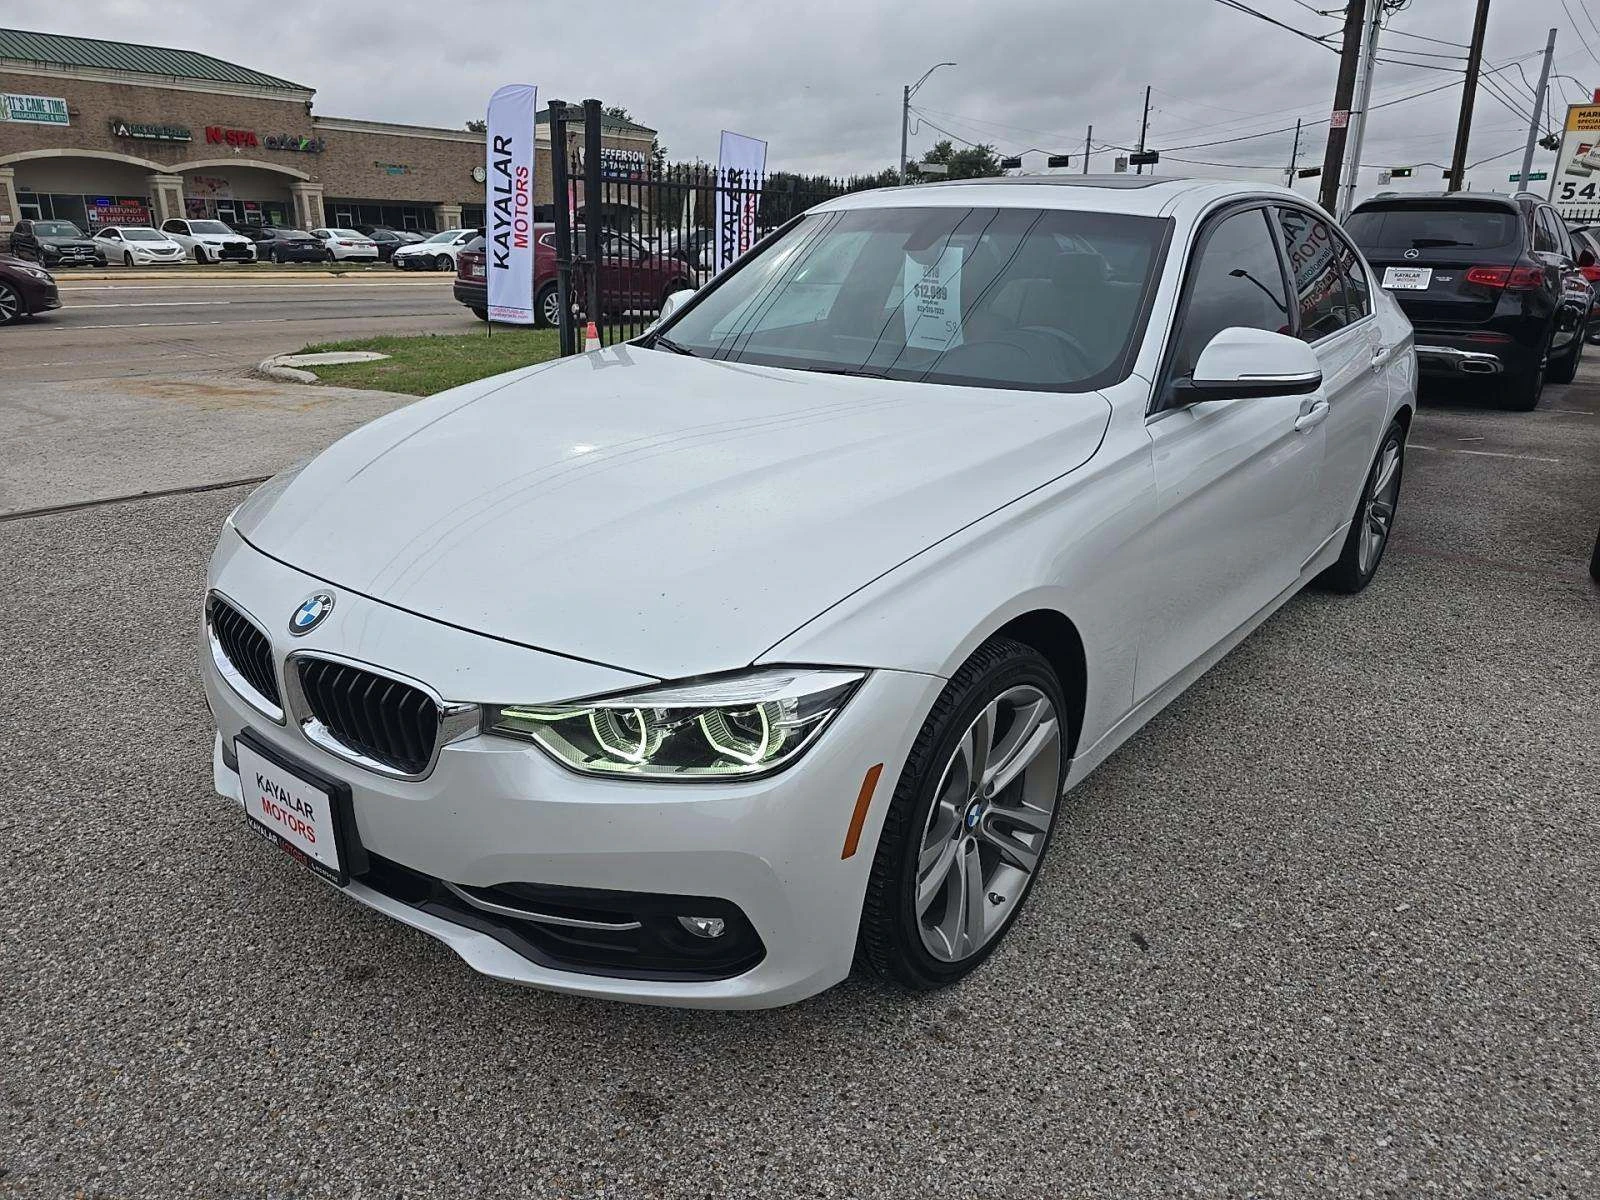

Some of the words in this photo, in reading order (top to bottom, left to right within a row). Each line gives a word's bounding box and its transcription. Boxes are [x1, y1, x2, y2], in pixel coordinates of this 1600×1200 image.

[8, 96, 25, 110] IT'S
[26, 98, 45, 111] CANE
[47, 99, 65, 114] TIME
[601, 148, 646, 163] EFFERSON
[493, 135, 512, 270] KAYALAR
[514, 165, 529, 249] MOTORS
[723, 168, 743, 264] AYALAR
[256, 772, 315, 822] KAYALAR
[262, 797, 315, 843] MOTORS
